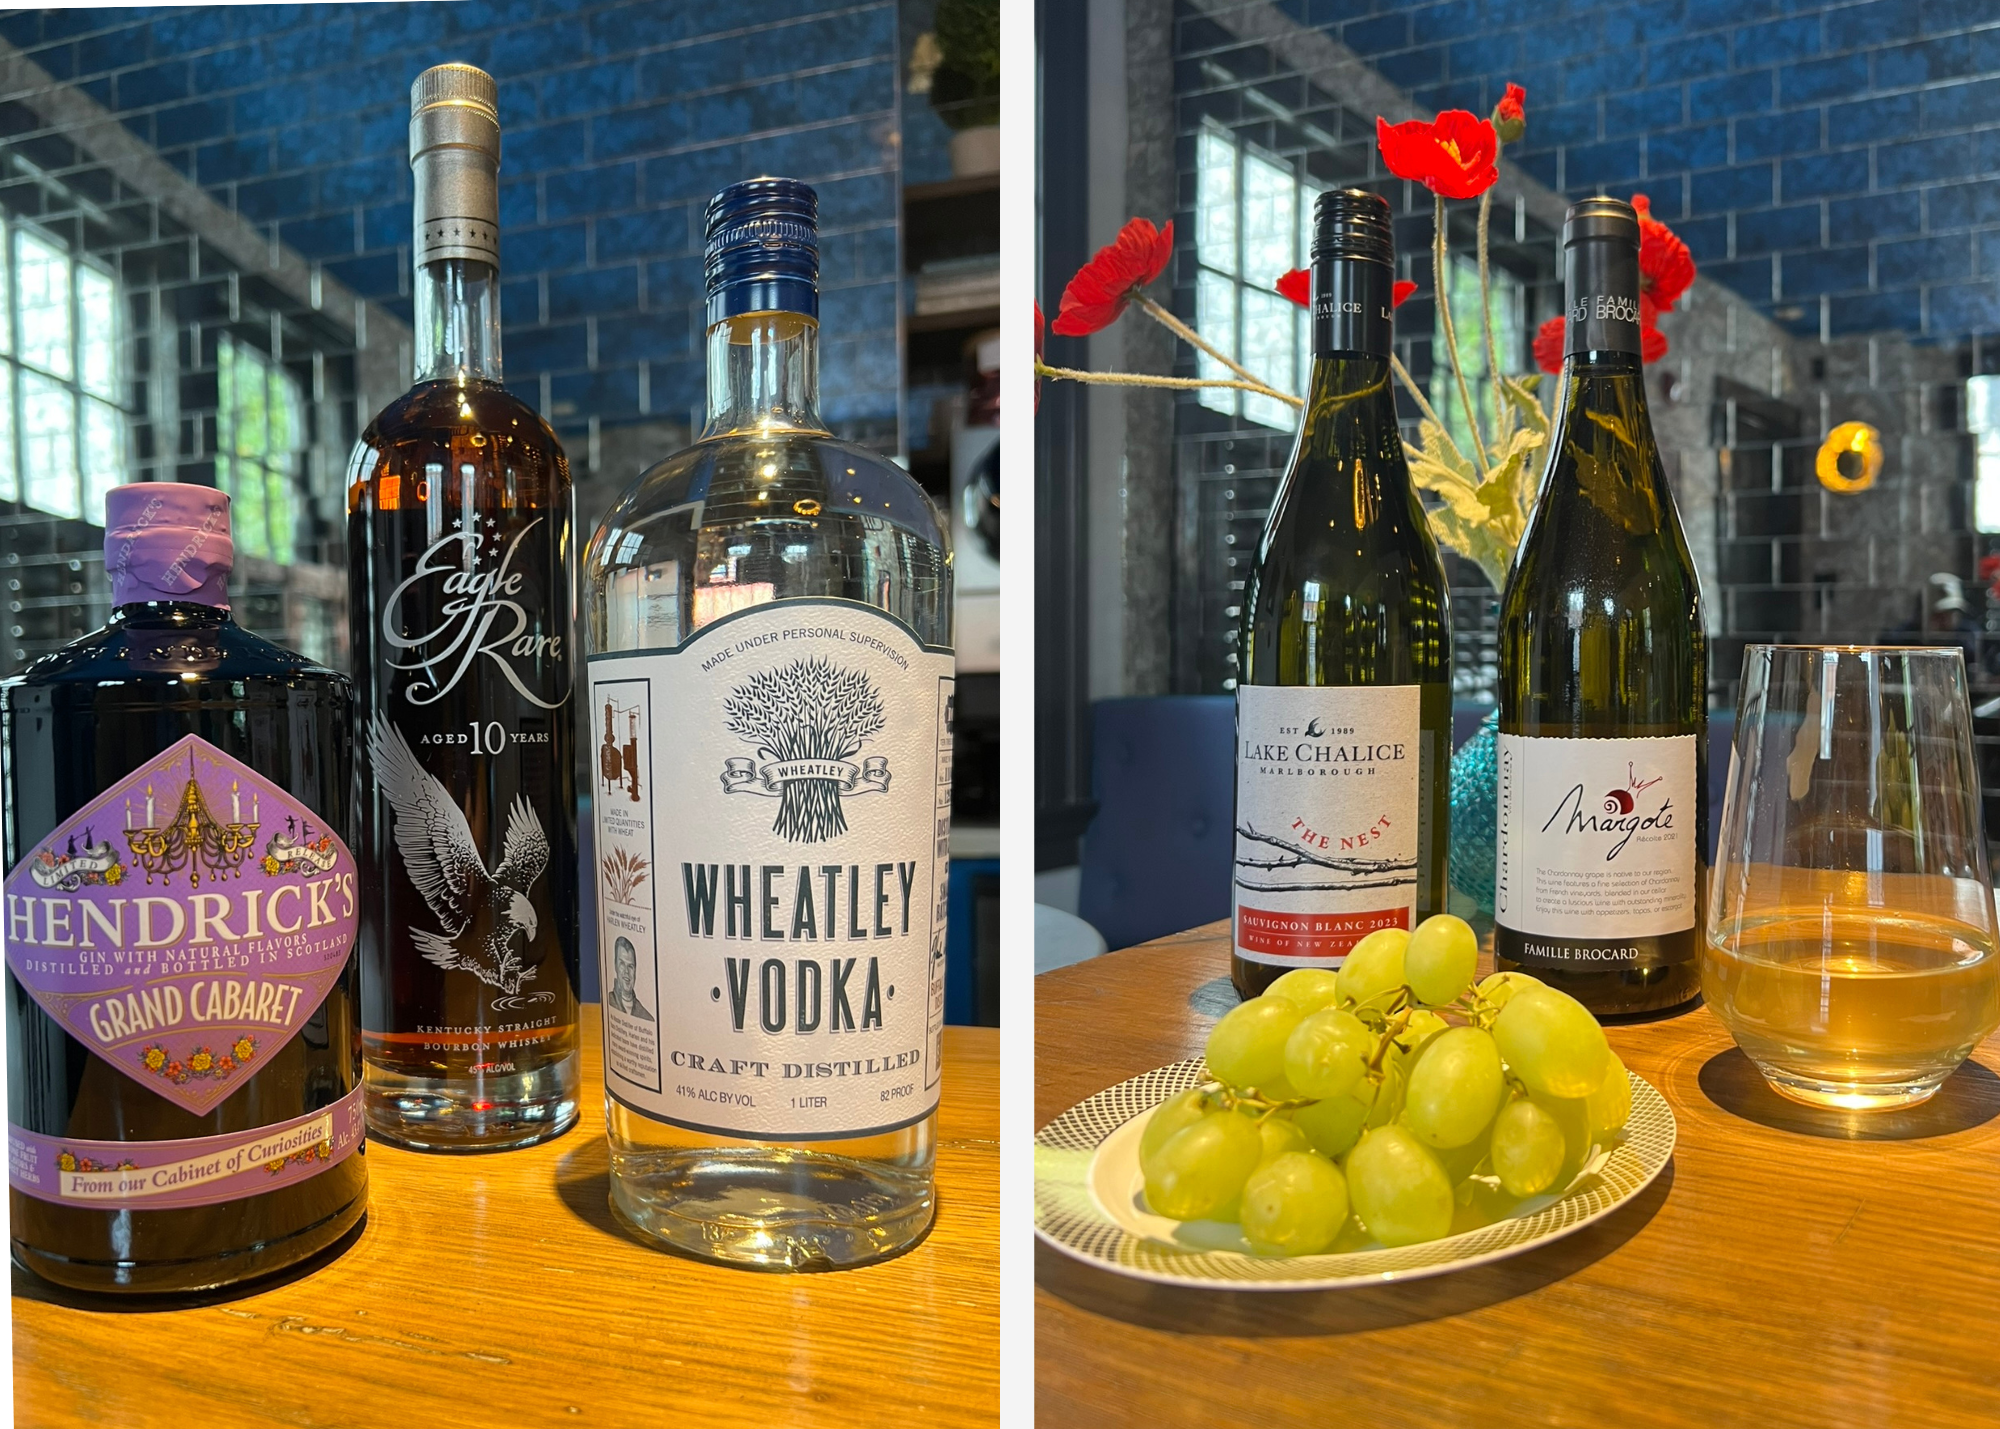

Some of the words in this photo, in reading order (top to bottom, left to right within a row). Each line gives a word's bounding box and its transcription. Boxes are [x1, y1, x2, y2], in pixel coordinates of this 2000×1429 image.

[1315, 302, 1362, 315] HALICE
[161, 505, 222, 587] HENDRICK'S
[383, 517, 544, 669] Eagle
[406, 600, 571, 709] Rare
[702, 647, 734, 672] MADE
[735, 631, 779, 653] UNDER
[782, 627, 846, 640] PERSONAL
[849, 631, 909, 671] SUPERVISION
[420, 733, 468, 744] AGED
[469, 721, 506, 755] 10
[510, 732, 550, 743] YEARS
[1279, 727, 1299, 735] EST
[1331, 727, 1355, 735] 1989
[1245, 740, 1289, 761] LAKE
[1295, 743, 1406, 762] CHALICE
[778, 764, 845, 778] WHEATLEY
[1260, 767, 1376, 776] MARLBOROUGH
[616, 818, 645, 829] QUANTITIES
[1291, 816, 1330, 849] THE
[1340, 814, 1392, 850] NEST
[1499, 745, 1513, 913] Chardonnay
[1541, 783, 1673, 861] Margote
[287, 849, 332, 868] RELEASE
[43, 859, 98, 886] LIMITED
[1547, 869, 1583, 879] Chardonnay
[1585, 871, 1604, 879] grape
[1613, 870, 1632, 878] native
[1564, 879, 1589, 887] features
[1612, 879, 1639, 887] selection
[7, 873, 354, 948] HENDRICK'S
[681, 861, 916, 941] WHEATLEY
[1243, 915, 1309, 931] SAUVIGNON
[1315, 920, 1364, 932] BLANC
[1369, 917, 1398, 929] 2023
[79, 951, 106, 963] GIN
[114, 950, 157, 963] WITH
[166, 944, 241, 961] NATURAL
[249, 933, 307, 954] FLAVORS
[1249, 934, 1271, 945] WINE
[1276, 939, 1289, 947] OF
[1297, 940, 1322, 948] NEW
[1524, 943, 1570, 959] FAMILLE
[1575, 947, 1638, 960] BROCARD
[26, 959, 114, 975] DISTILLED
[124, 963, 151, 975] and
[161, 955, 250, 974] BOTTLED
[260, 951, 278, 963] IN
[287, 933, 348, 959] SCOTLAND
[724, 956, 883, 1036] VODKA
[90, 985, 184, 1042] GRAND
[190, 980, 303, 1026] CABARET
[416, 1025, 492, 1035] KENTUCKY
[498, 1016, 557, 1033] STRAIGHT
[424, 1042, 490, 1051] BOURBON
[486, 1062, 516, 1074] ALC/VOL
[670, 1050, 770, 1078] CRAFT
[782, 1048, 920, 1079] DISTILLED
[675, 1084, 696, 1098] 41%
[698, 1088, 718, 1103] ALC
[720, 1091, 733, 1104] BY
[735, 1093, 757, 1108] VOL
[791, 1097, 795, 1108] 1
[799, 1096, 827, 1108] LITER
[880, 1089, 890, 1102] 82
[891, 1083, 915, 1100] PROOF
[71, 1175, 114, 1195] From
[118, 1176, 147, 1193] our
[152, 1163, 222, 1187] Cabinet
[226, 1149, 245, 1173] of
[248, 1126, 323, 1162] Curiosities
